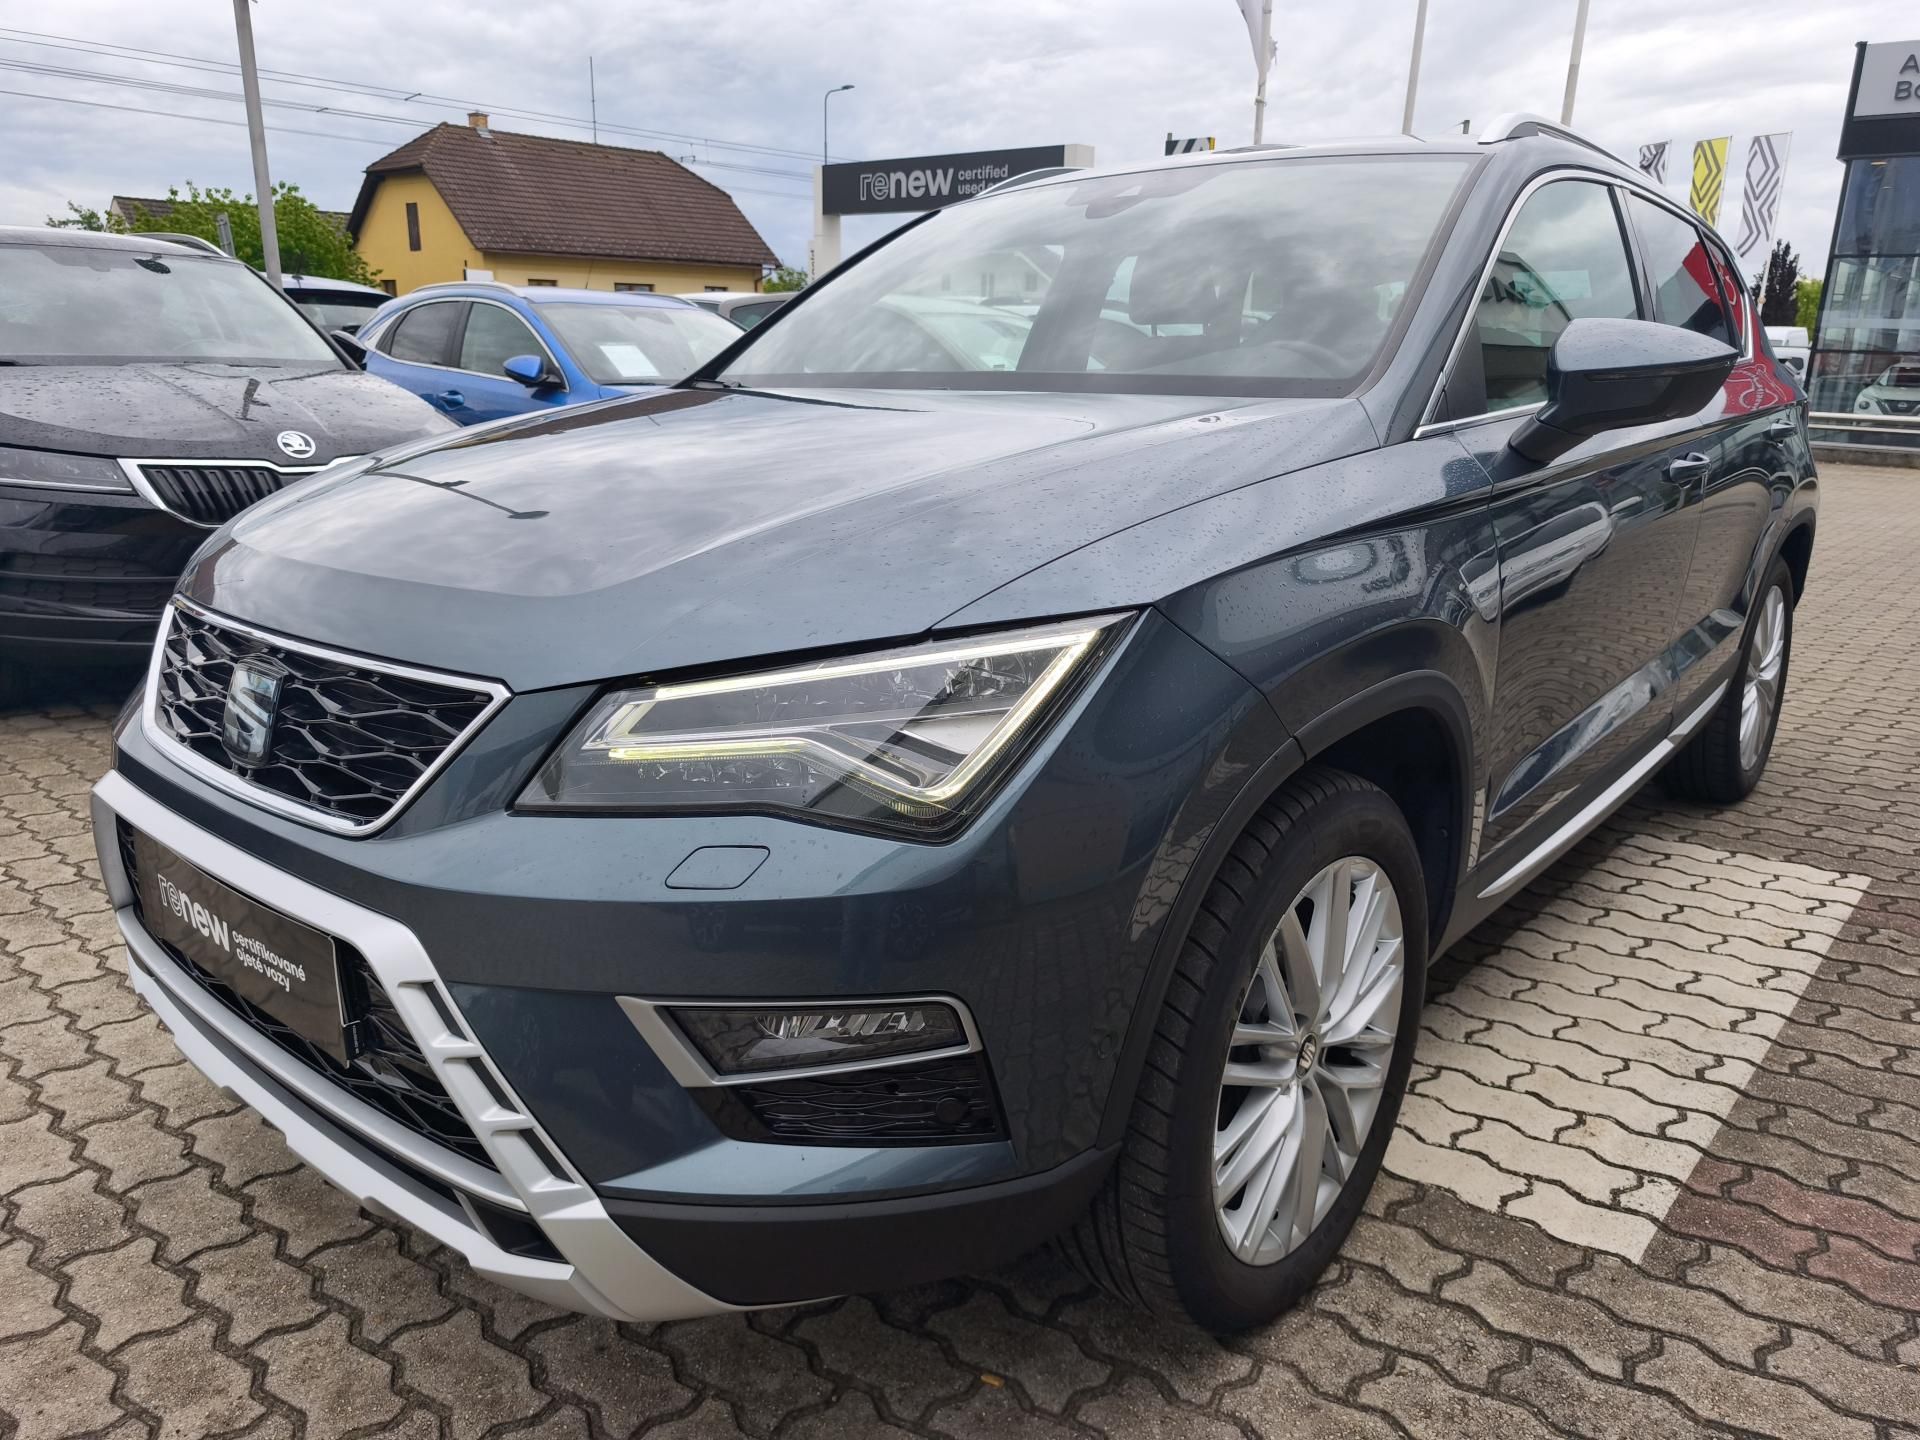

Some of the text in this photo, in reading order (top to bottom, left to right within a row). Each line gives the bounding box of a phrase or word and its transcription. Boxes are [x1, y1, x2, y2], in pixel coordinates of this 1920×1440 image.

[859, 167, 954, 201] renew
[957, 180, 986, 195] used
[958, 164, 1009, 181] certified
[157, 874, 230, 953] renew
[232, 929, 306, 982] certifikované
[237, 947, 291, 992] ojeté vozy
